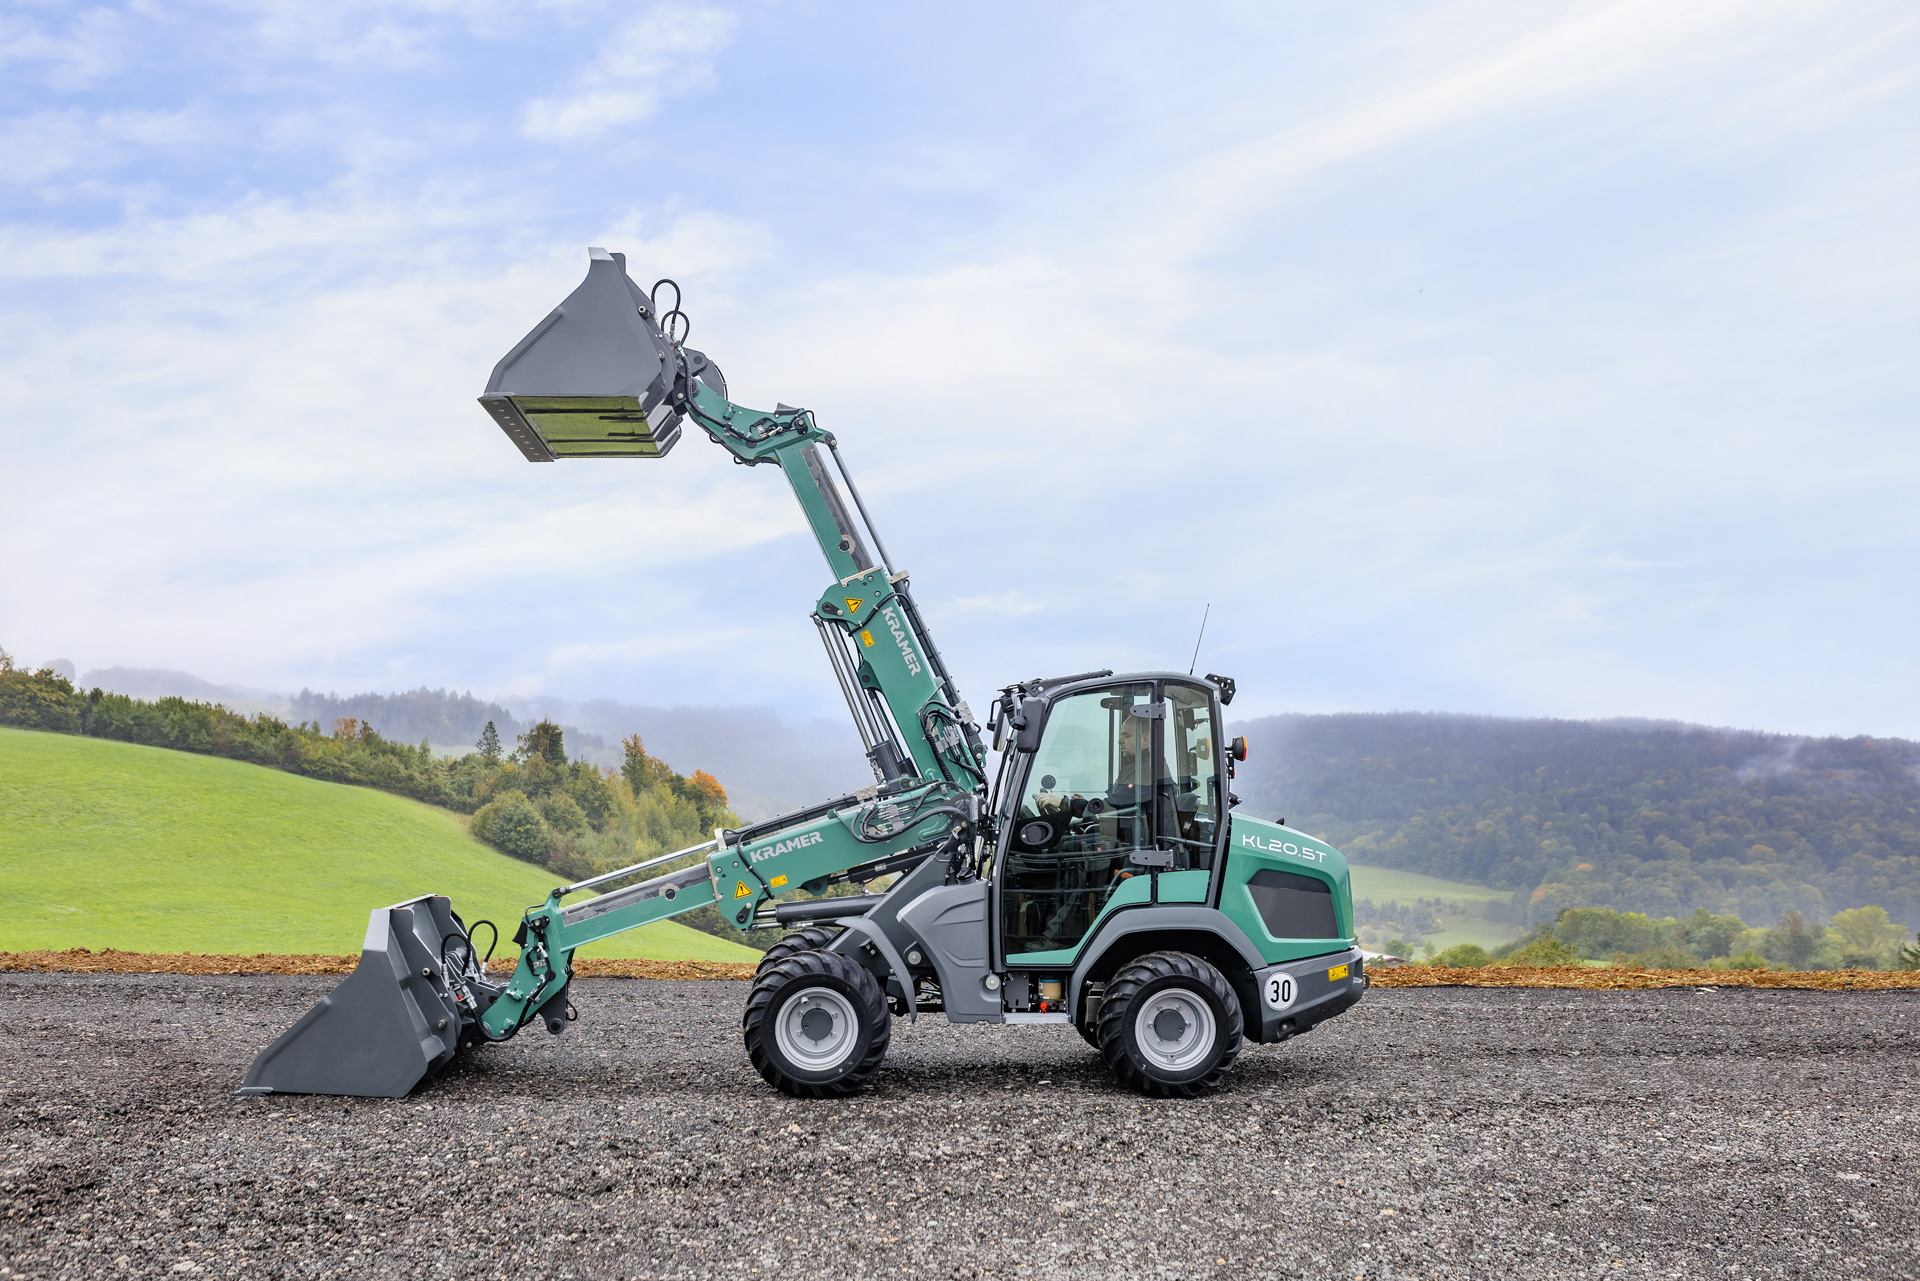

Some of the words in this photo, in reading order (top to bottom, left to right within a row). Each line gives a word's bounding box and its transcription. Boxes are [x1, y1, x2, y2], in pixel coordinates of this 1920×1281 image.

[882, 606, 921, 677] KRAMER
[750, 831, 824, 863] KRAMER
[1242, 834, 1327, 862] KL20.5T
[1270, 979, 1291, 1003] 30
